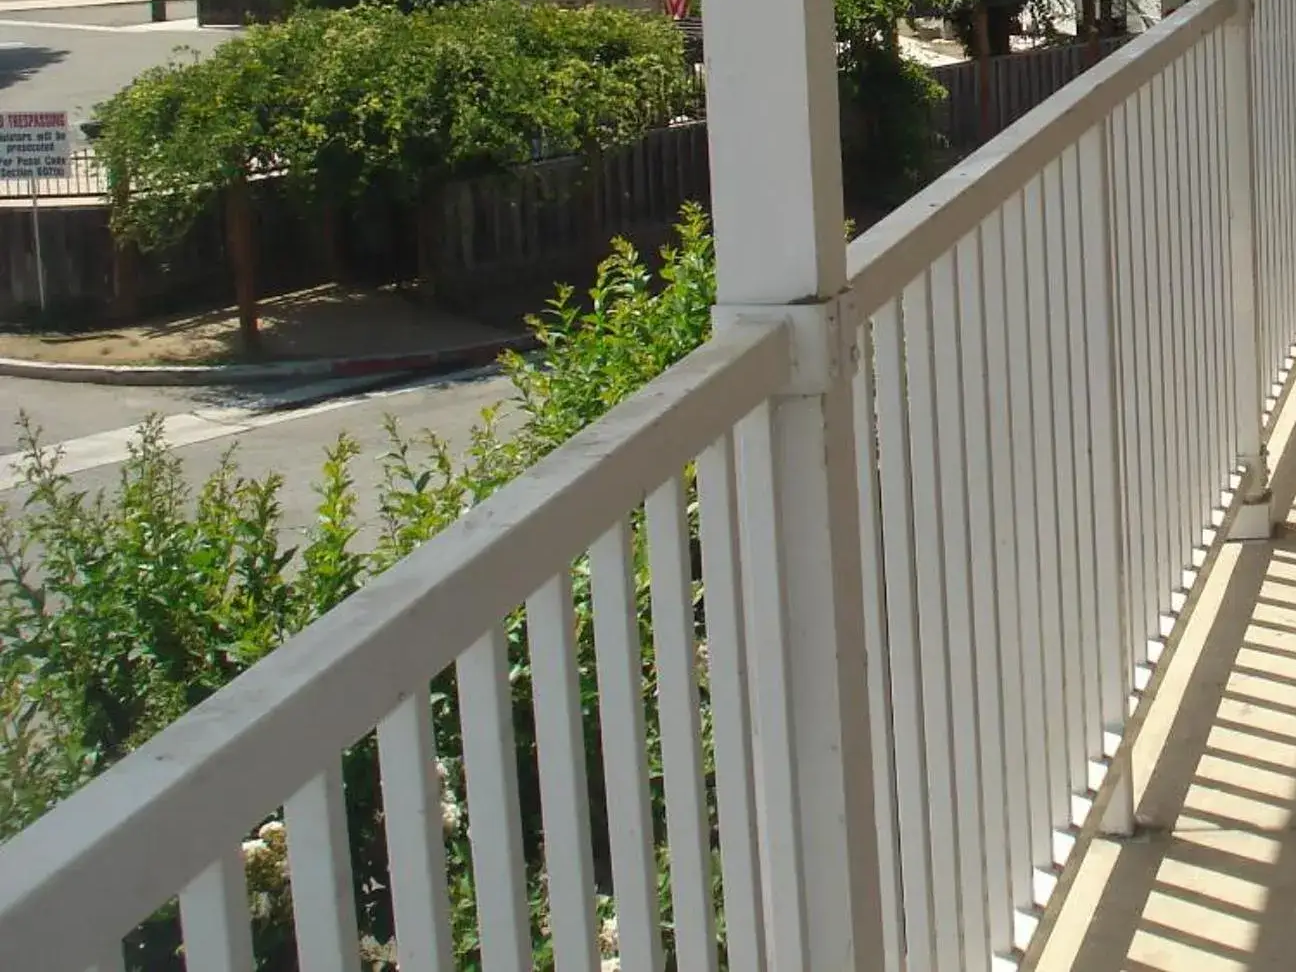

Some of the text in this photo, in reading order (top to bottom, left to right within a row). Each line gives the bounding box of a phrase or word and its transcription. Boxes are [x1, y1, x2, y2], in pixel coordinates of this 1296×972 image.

[8, 113, 65, 128] TRESPASSING
[36, 130, 52, 141] will
[55, 129, 66, 141] be
